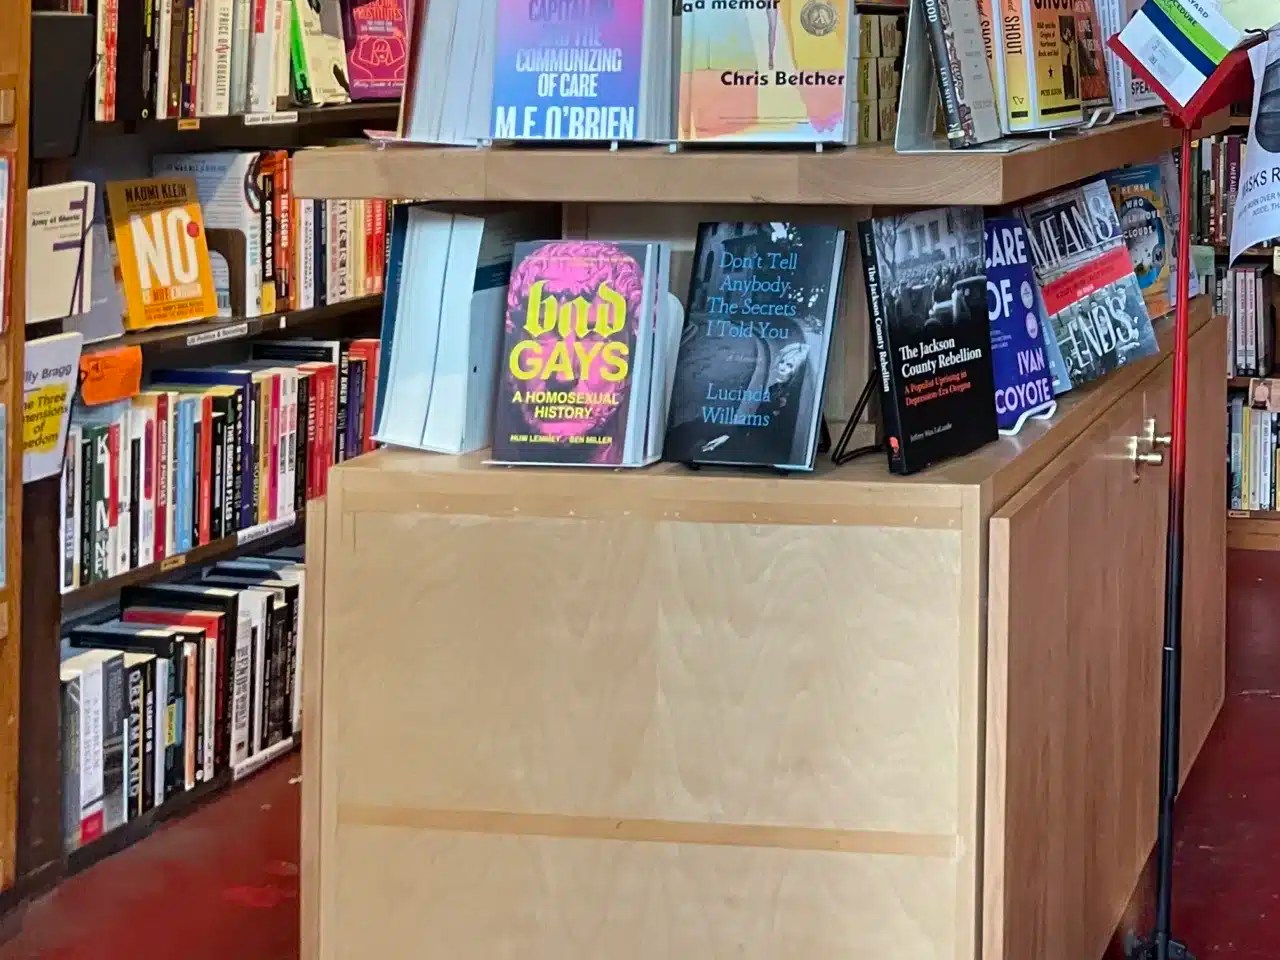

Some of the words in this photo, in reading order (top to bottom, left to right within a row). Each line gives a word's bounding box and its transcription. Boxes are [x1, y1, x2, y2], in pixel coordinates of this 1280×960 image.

[1004, 15, 1023, 55] SHOUT
[515, 47, 623, 74] COMMUNIZING
[537, 73, 561, 98] OF
[563, 72, 599, 98] CARE
[720, 69, 769, 87] Chris
[775, 69, 846, 87] Belcher
[544, 106, 636, 139] O'BRIEN
[125, 185, 159, 203] NAOMI
[162, 183, 188, 199] KLEIN
[1125, 198, 1144, 208] WHO
[1027, 194, 1114, 268] MEANS
[129, 206, 200, 290] NO
[719, 251, 763, 270] Don't
[767, 251, 798, 270] Tell
[719, 276, 790, 298] Anybody
[870, 281, 882, 316] Jackson
[987, 278, 1014, 322] OF
[523, 280, 628, 338] bad
[707, 297, 738, 316] The
[742, 298, 797, 318] Secrets
[715, 320, 755, 339] Told
[758, 322, 789, 339] You
[874, 317, 886, 347] County
[1068, 287, 1136, 369] ENDS
[509, 340, 630, 382] GAYS
[899, 345, 917, 361] The
[919, 336, 956, 355] Jackson
[1017, 347, 1044, 376] IVAN
[41, 364, 72, 380] Bragg
[878, 347, 890, 392] Rebellion
[901, 359, 937, 379] County
[938, 347, 982, 369] Rebellion
[340, 377, 349, 404] KNEW
[512, 390, 524, 404] A
[526, 390, 619, 406] HOMOSEXUAL
[706, 384, 772, 403] Lucinda
[995, 377, 1051, 415] COYOTE
[534, 405, 593, 420] HISTORY
[702, 406, 770, 427] Williams
[128, 669, 141, 798] DREAMLAND
